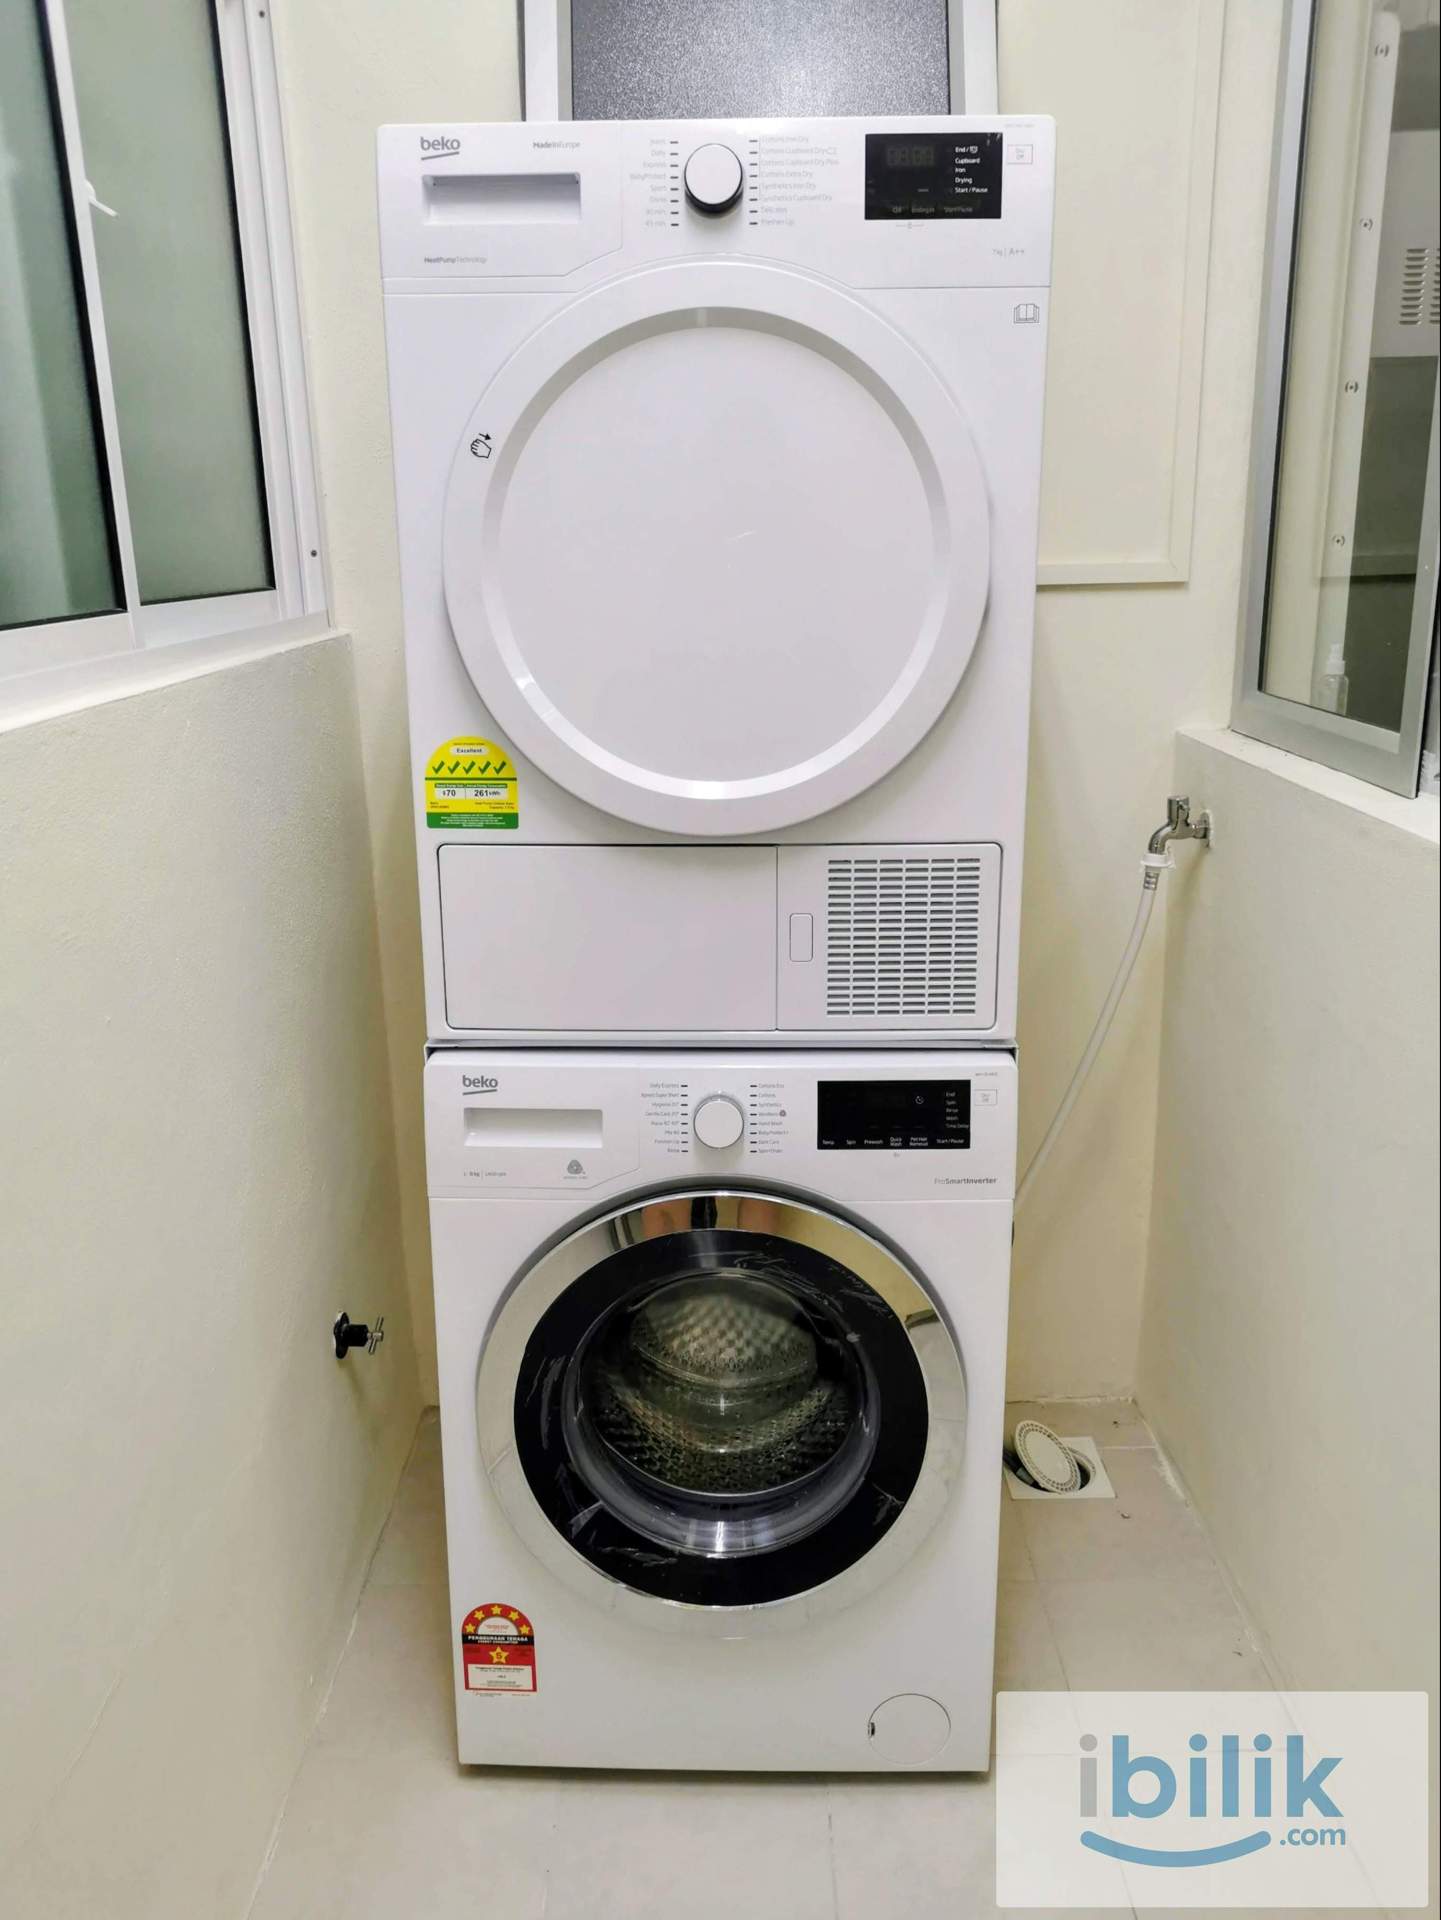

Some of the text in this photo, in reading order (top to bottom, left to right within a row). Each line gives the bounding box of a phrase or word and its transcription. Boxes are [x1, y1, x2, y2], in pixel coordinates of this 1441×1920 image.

[420, 136, 461, 151] beko
[955, 157, 980, 165] Cupboard
[462, 1075, 498, 1088] beko
[933, 1177, 997, 1185] ProSmartInverter
